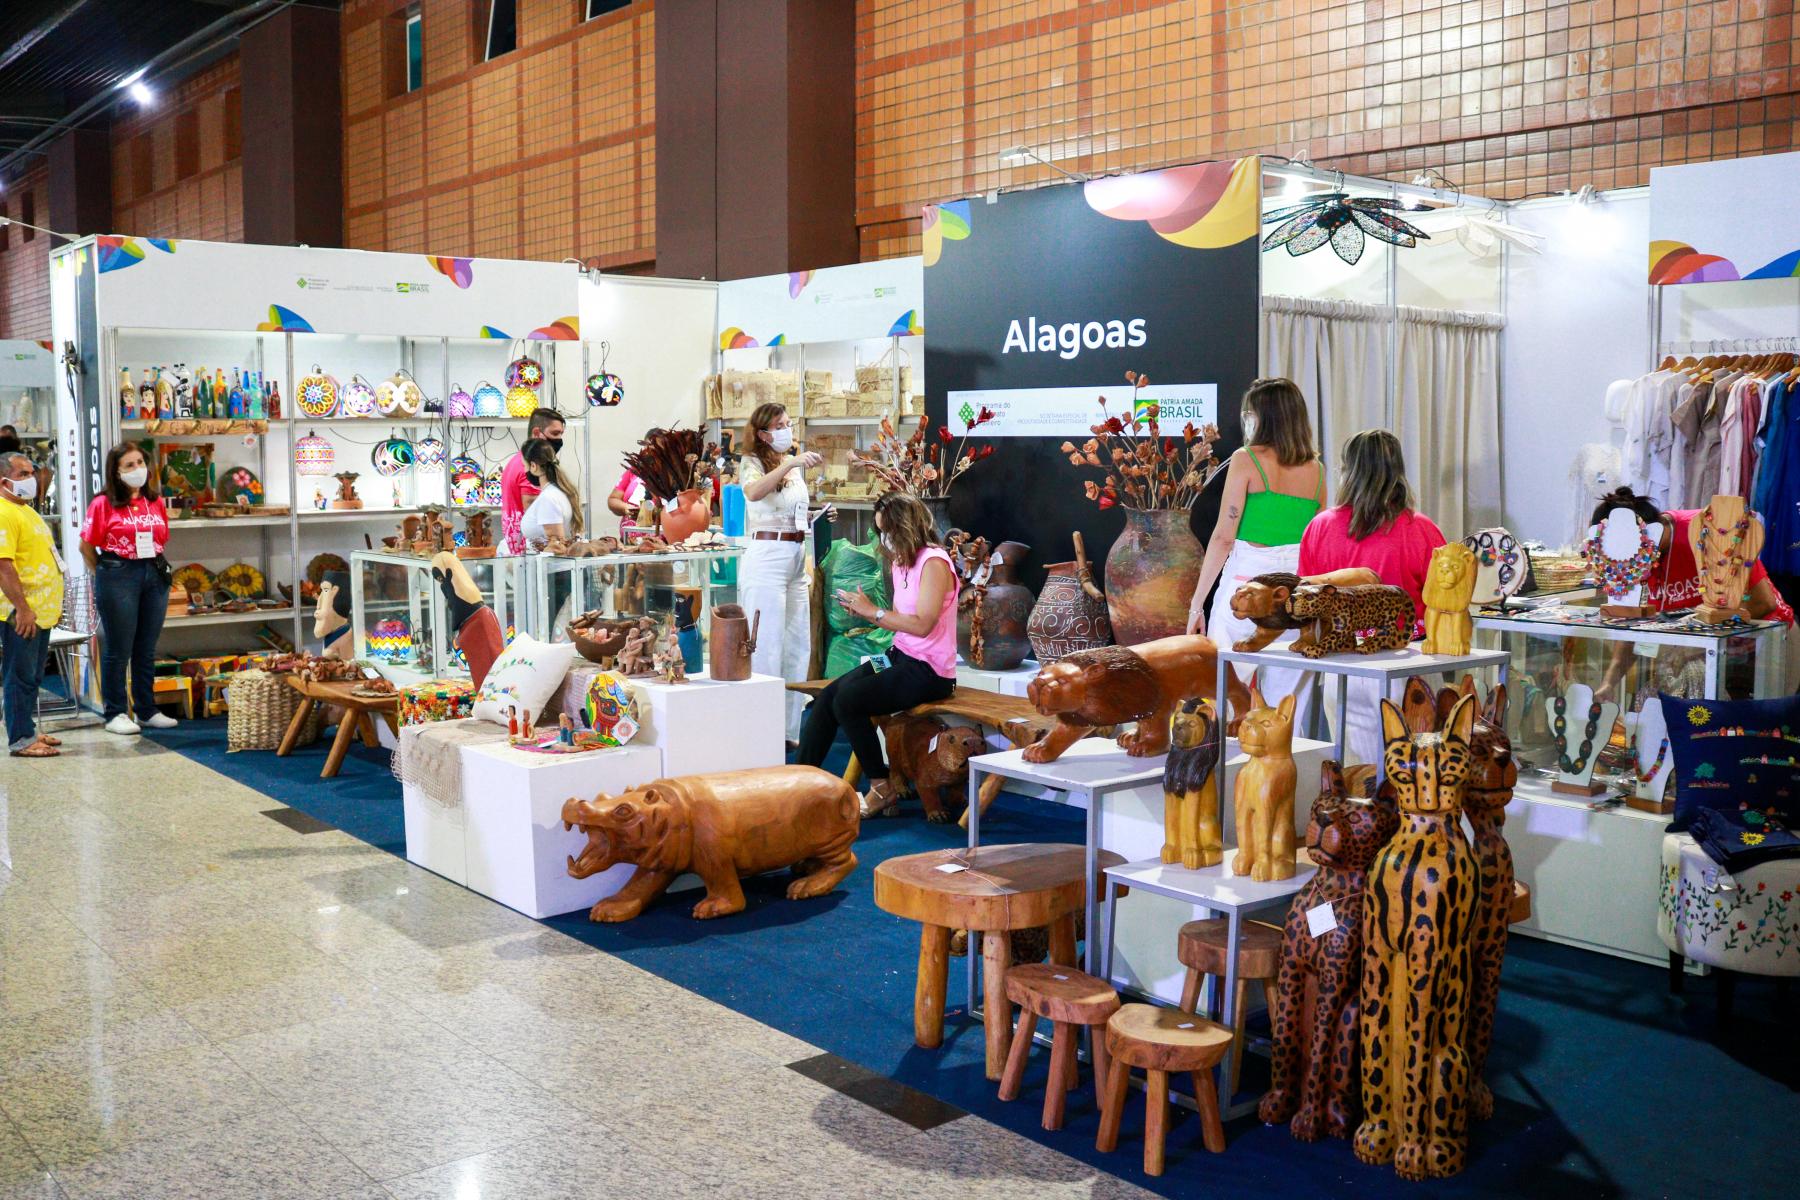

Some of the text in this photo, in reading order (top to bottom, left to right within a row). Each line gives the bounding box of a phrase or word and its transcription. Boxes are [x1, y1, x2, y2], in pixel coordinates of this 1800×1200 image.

[1002, 316, 1147, 360] Alagoas
[1160, 406, 1203, 418] BRASIL
[89, 406, 101, 495] goas
[68, 429, 79, 528] Bahia
[123, 513, 163, 525] ALAGOA
